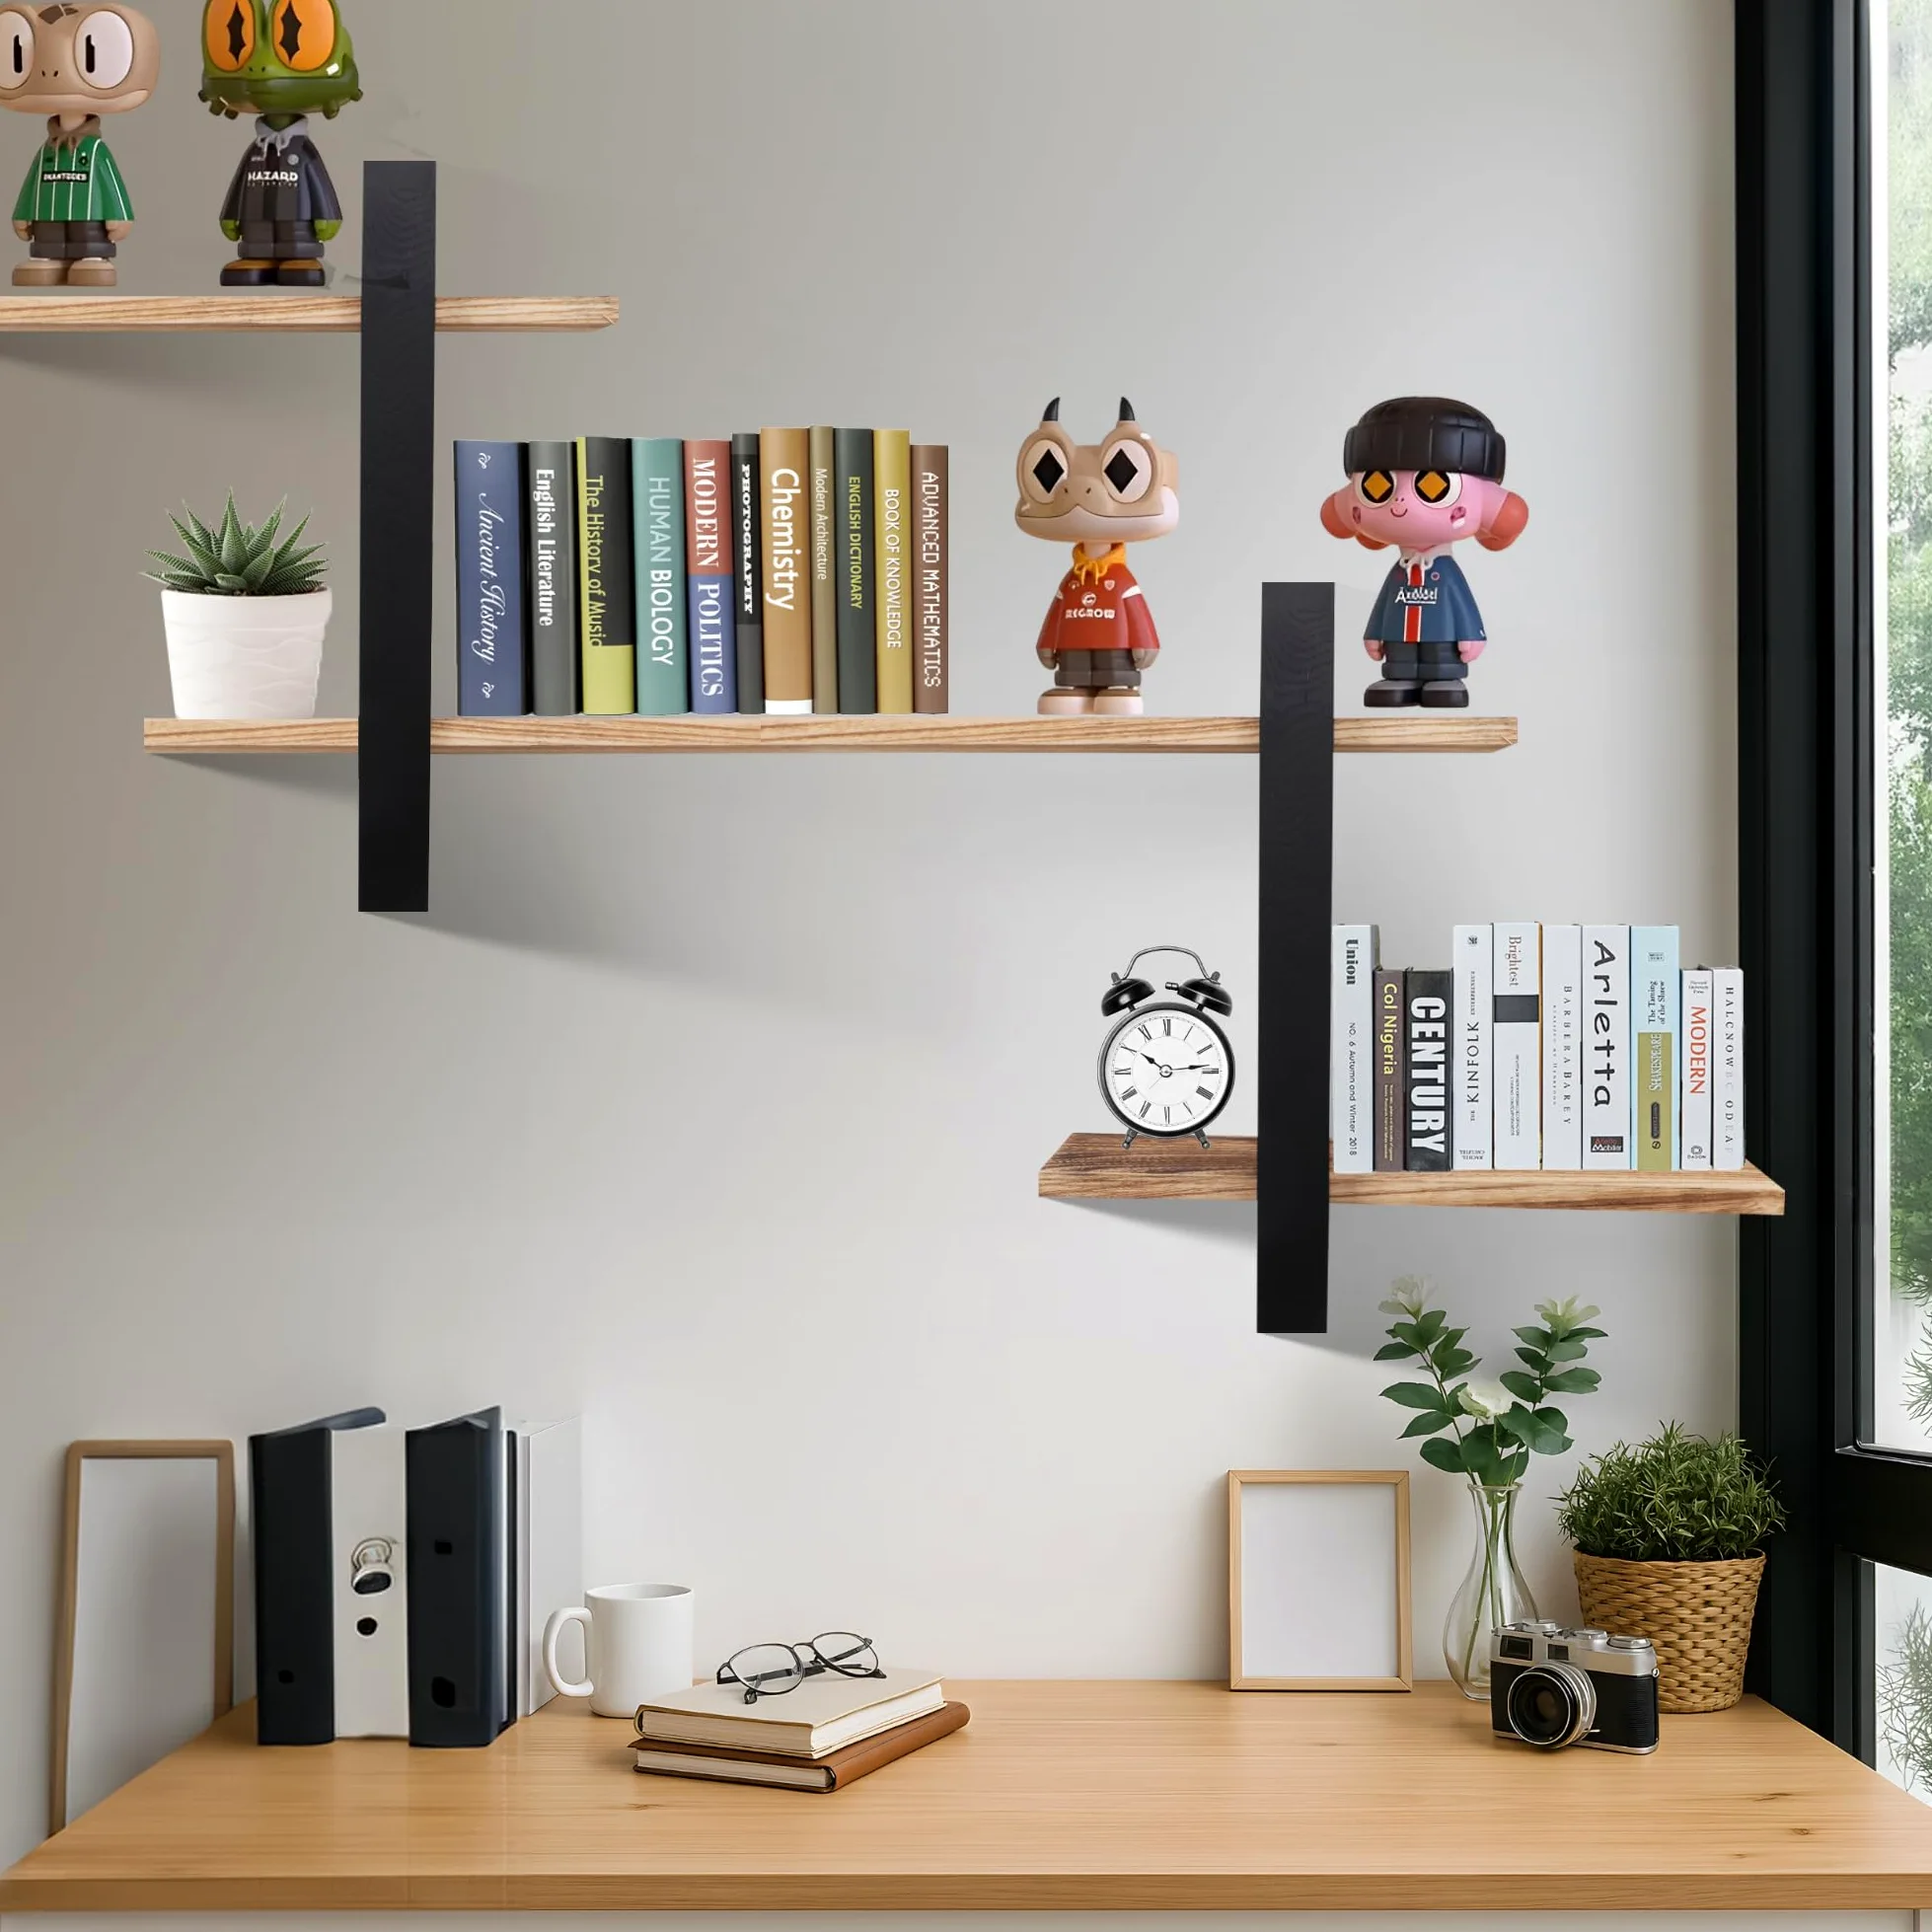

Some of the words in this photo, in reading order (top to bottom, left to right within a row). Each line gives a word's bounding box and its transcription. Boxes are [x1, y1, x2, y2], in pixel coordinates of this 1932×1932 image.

[248, 171, 298, 182] HAZARD
[534, 469, 555, 533] English
[586, 476, 604, 507] The
[648, 477, 671, 562] HUMAN
[693, 458, 719, 567] MODERN
[816, 468, 827, 511] Modern
[849, 477, 860, 530] ENGLISH
[885, 488, 900, 531] BOOK
[922, 472, 938, 562] ADVANCED
[479, 493, 505, 578] Ancient
[587, 513, 604, 574] History
[741, 464, 753, 614] PHOTOGRAPHY
[766, 468, 801, 610] Chemistry
[816, 514, 828, 580] Architecture
[850, 533, 862, 609] DICTIONARY
[886, 534, 900, 554] OF
[538, 540, 556, 626] Literature
[588, 578, 606, 597] of
[650, 569, 673, 665] BIOLOGY
[887, 557, 901, 648] KNOWLEDGE
[472, 580, 506, 664] History
[589, 601, 606, 647] Music
[698, 583, 723, 697] POLITICS
[923, 569, 940, 688] MATHEMATICS
[1346, 939, 1358, 985] Union
[1383, 984, 1397, 1009] Col
[1506, 936, 1522, 987] Brightest
[1380, 1015, 1397, 1075] Nigeria
[1594, 940, 1617, 1107] Arletta
[1690, 1006, 1706, 1093] MODERN
[1411, 997, 1446, 1152] CENTURY
[1467, 1022, 1479, 1103] KINFOLK
[1563, 1072, 1572, 1125] BAREY
